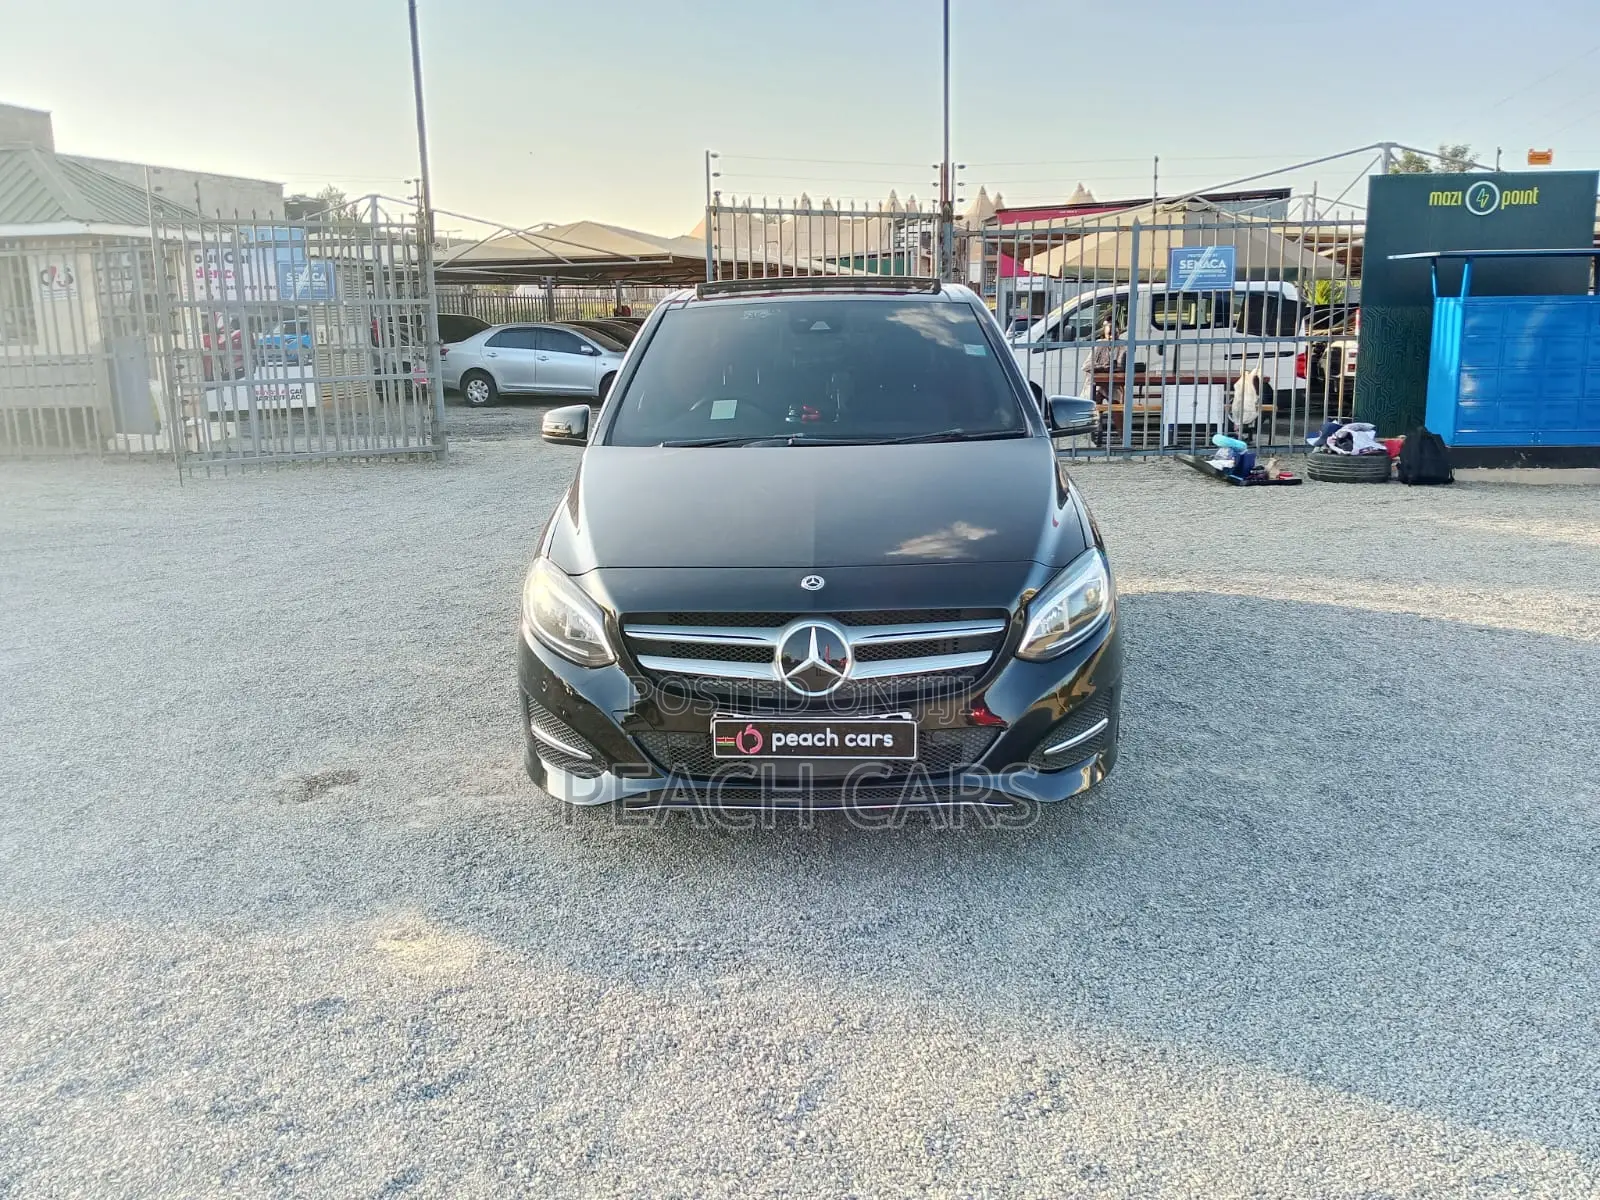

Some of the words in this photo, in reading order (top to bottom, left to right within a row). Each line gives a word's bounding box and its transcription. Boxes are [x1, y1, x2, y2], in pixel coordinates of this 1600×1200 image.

[1429, 191, 1462, 206] mazi
[1501, 186, 1539, 210] point
[772, 728, 839, 752] peach
[845, 732, 894, 747] cars
